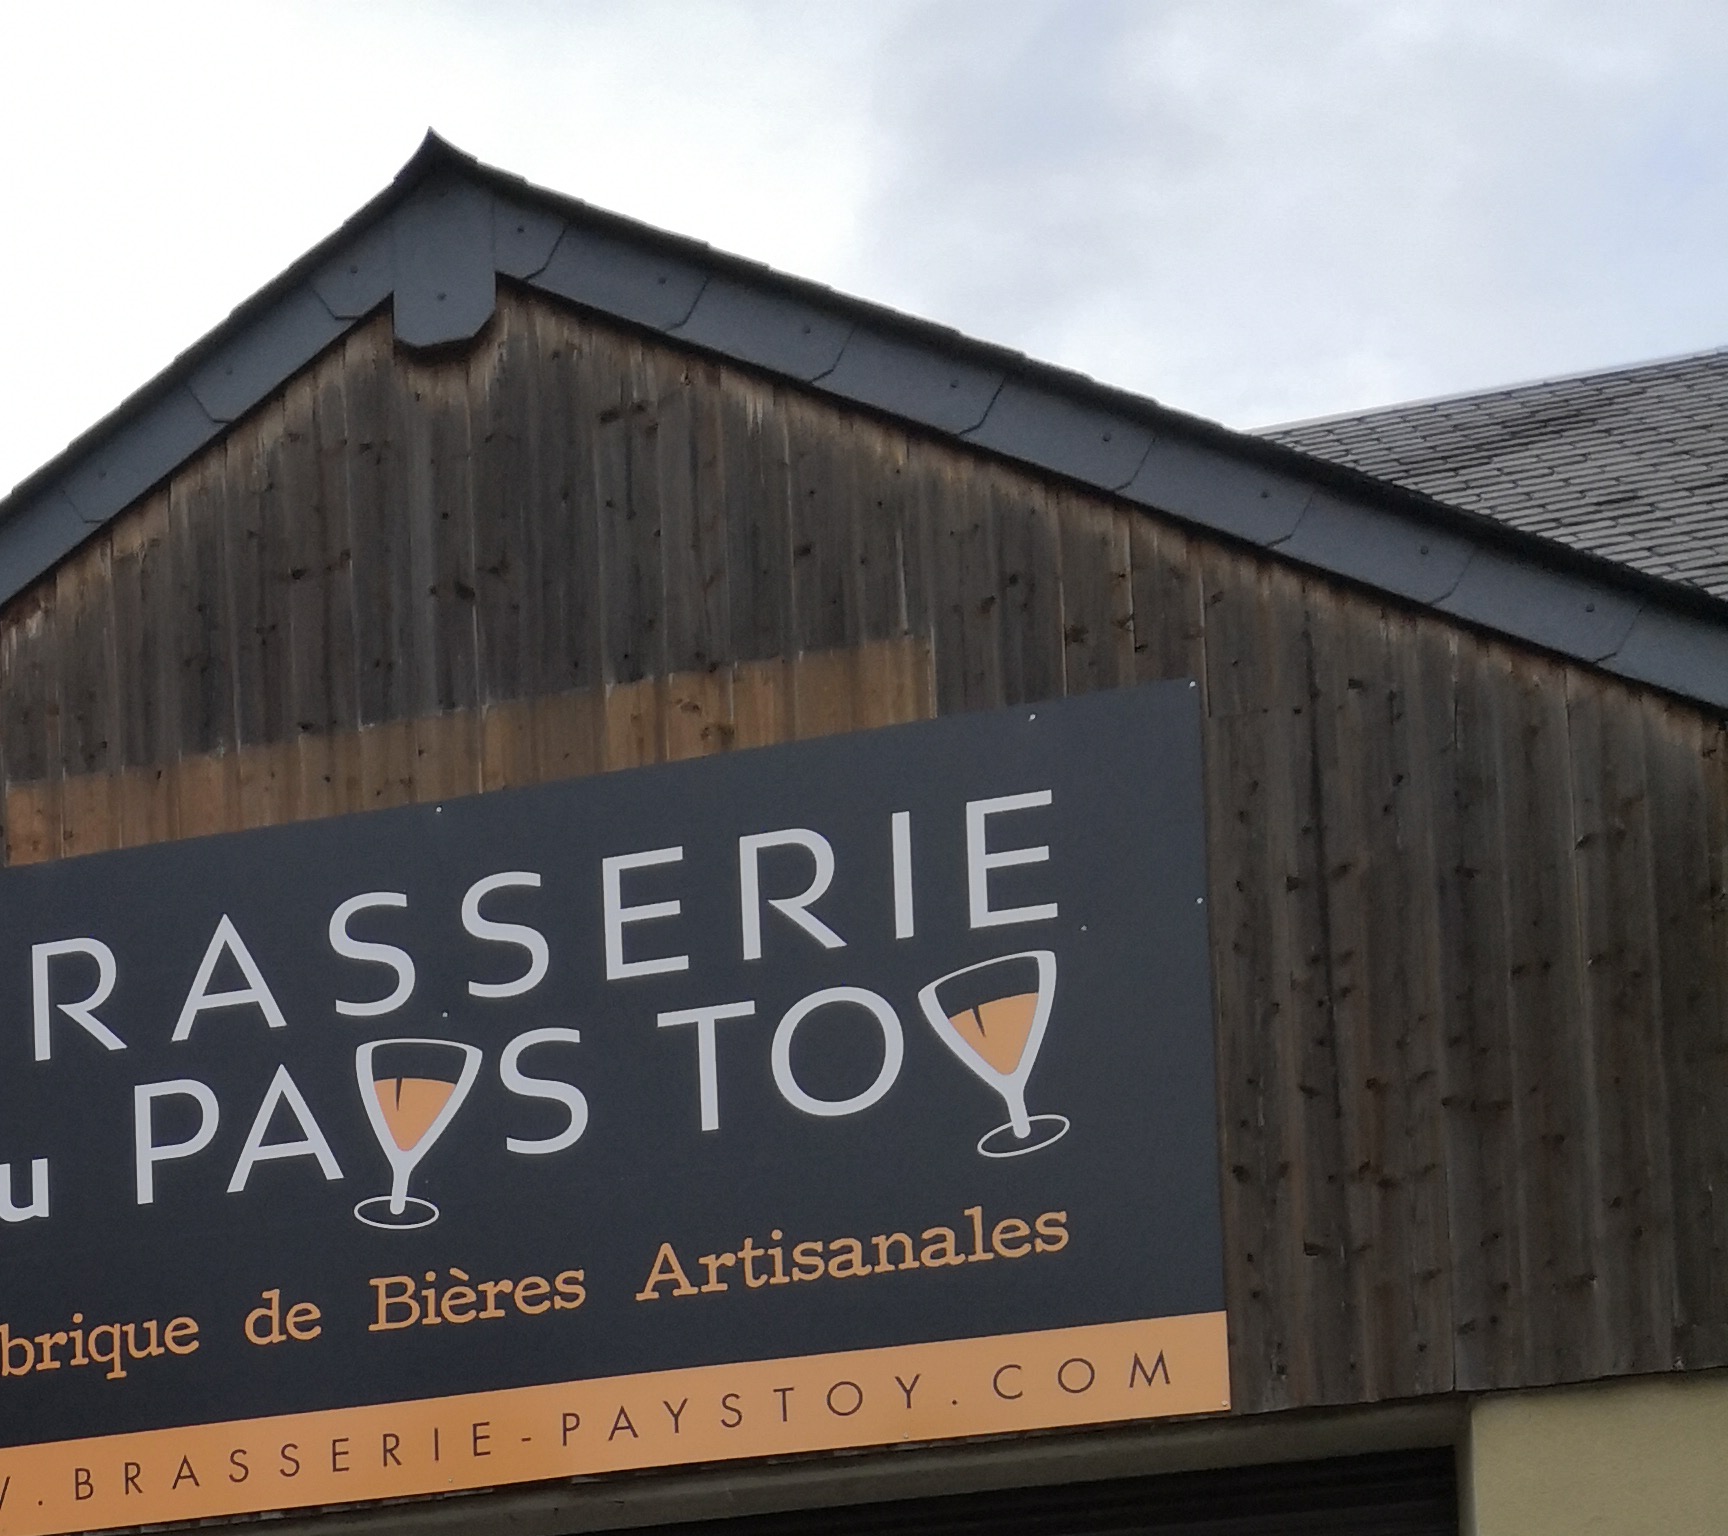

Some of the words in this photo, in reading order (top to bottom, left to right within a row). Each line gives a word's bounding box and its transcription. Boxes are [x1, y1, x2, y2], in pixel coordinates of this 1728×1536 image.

[132, 1027, 591, 1230] PAYS
[657, 948, 1071, 1158] TOY
[243, 1290, 323, 1347] de
[368, 1261, 587, 1332] Bières
[635, 1205, 1071, 1303] Artisanales
